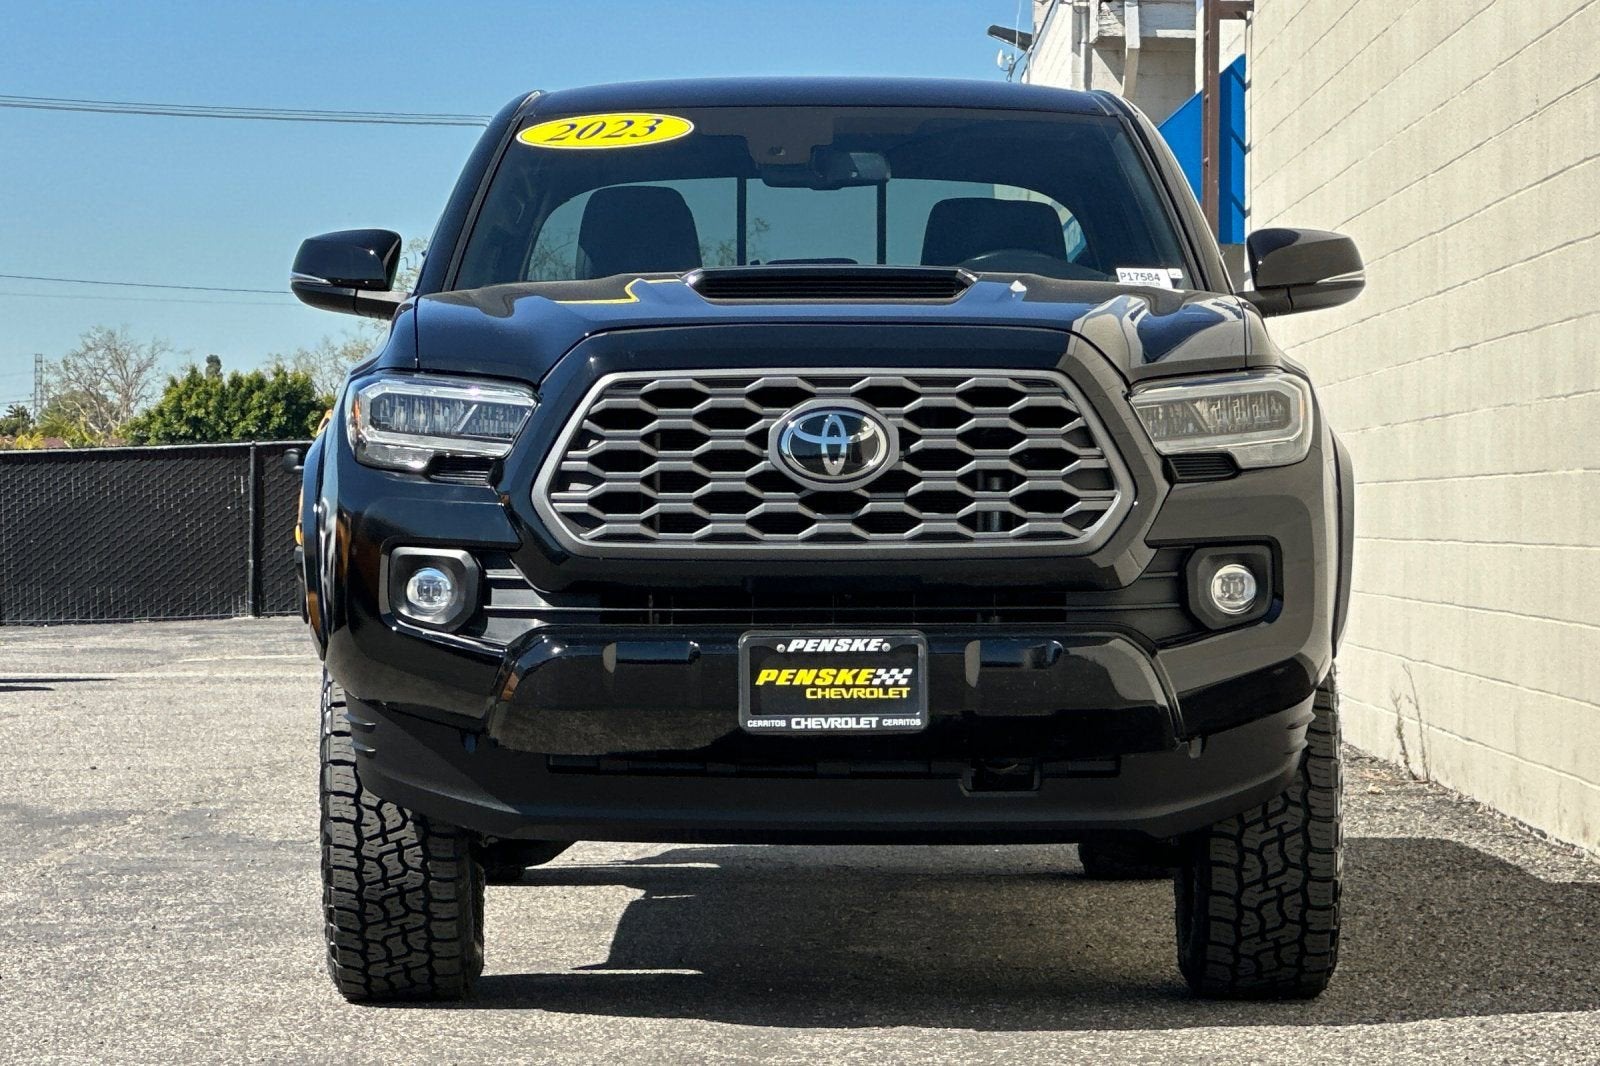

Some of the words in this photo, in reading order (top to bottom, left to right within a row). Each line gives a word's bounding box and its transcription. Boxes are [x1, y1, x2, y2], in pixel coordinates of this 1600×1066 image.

[543, 118, 663, 141] 2023
[1120, 272, 1161, 281] P17584
[787, 638, 884, 652] PENSKE
[755, 668, 877, 686] PENSKE
[805, 687, 911, 699] CHEVROLET
[747, 719, 786, 728] CERRITOS
[791, 717, 879, 729] CHEVROLET
[882, 718, 922, 727] CERRITOS
